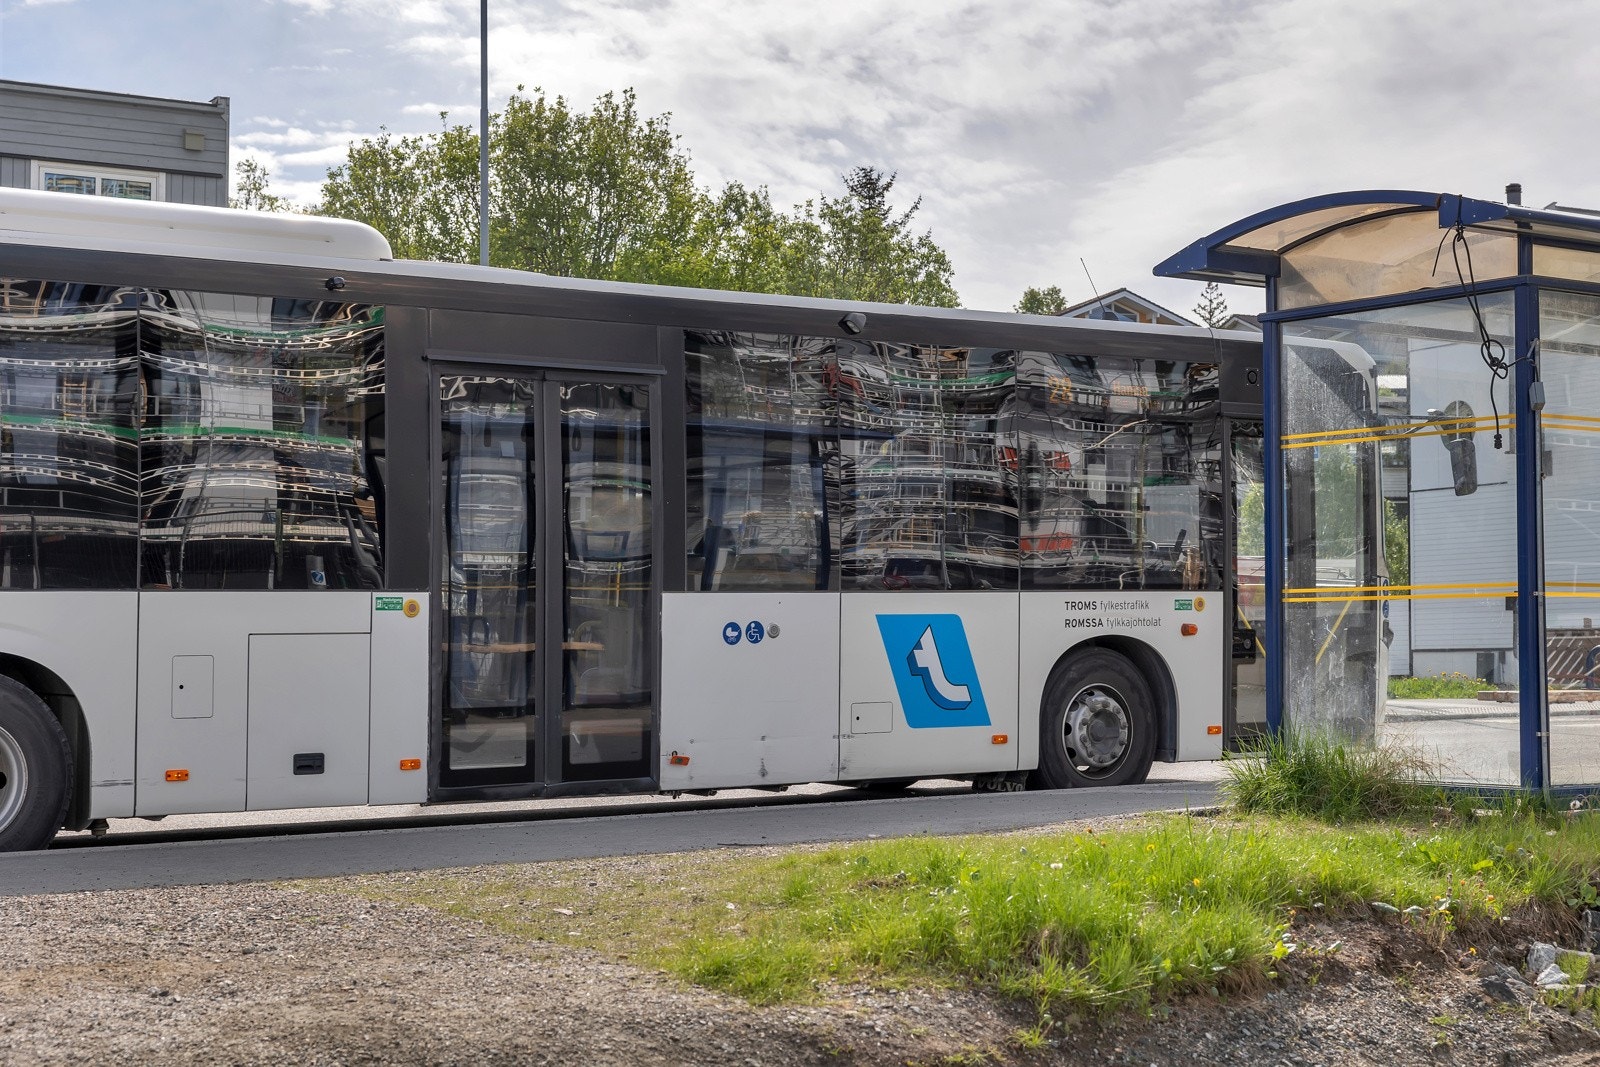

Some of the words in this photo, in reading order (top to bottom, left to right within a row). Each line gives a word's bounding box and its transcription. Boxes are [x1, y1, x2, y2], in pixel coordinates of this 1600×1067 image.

[1048, 375, 1072, 404] 28
[1064, 601, 1098, 611] TROMS
[1100, 600, 1150, 613] fylkestrafikk
[1064, 618, 1104, 629] ROMSSA
[1106, 617, 1162, 630] fylkkajohtolat
